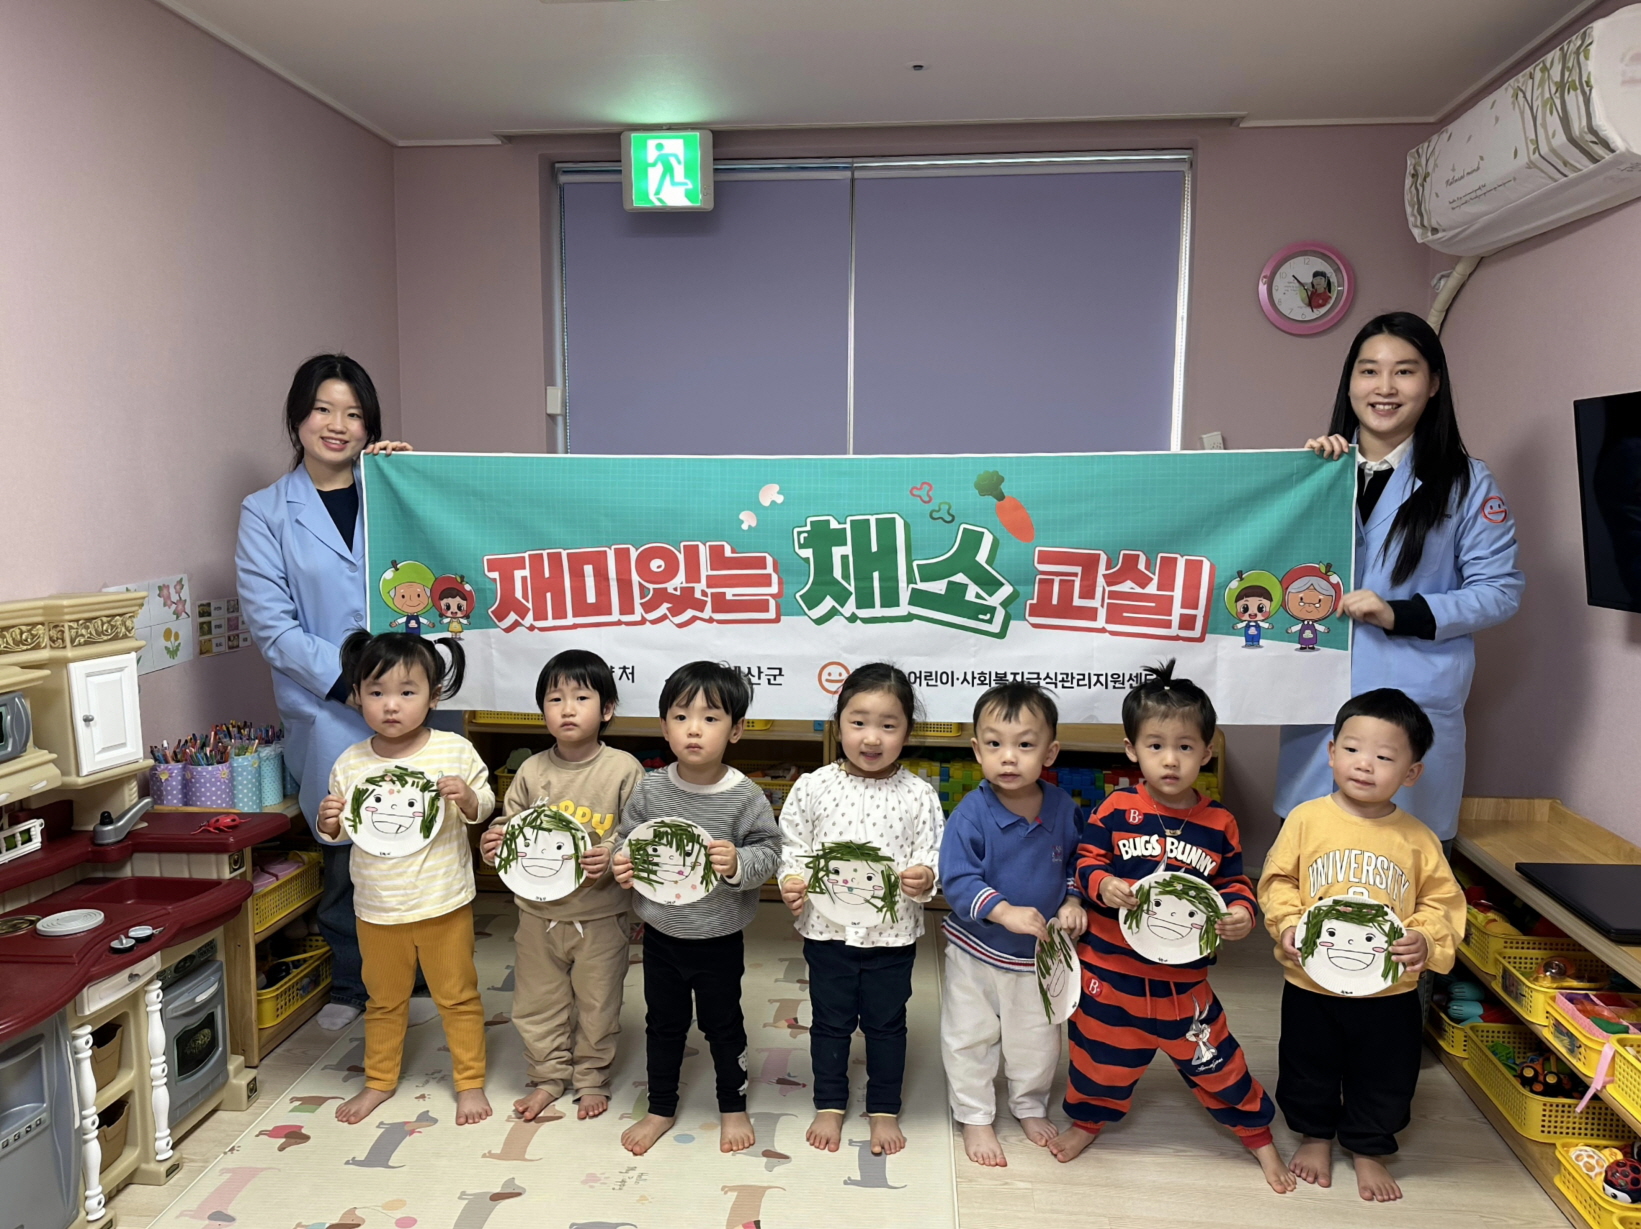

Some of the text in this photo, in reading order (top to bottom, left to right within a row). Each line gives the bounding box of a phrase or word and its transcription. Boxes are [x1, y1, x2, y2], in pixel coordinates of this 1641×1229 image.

[483, 513, 1216, 643] 재미있는 채소 교실!
[610, 665, 635, 684] 처
[1118, 834, 1216, 876] BUGS BUNNY
[1308, 848, 1410, 901] UNIVERSITY
